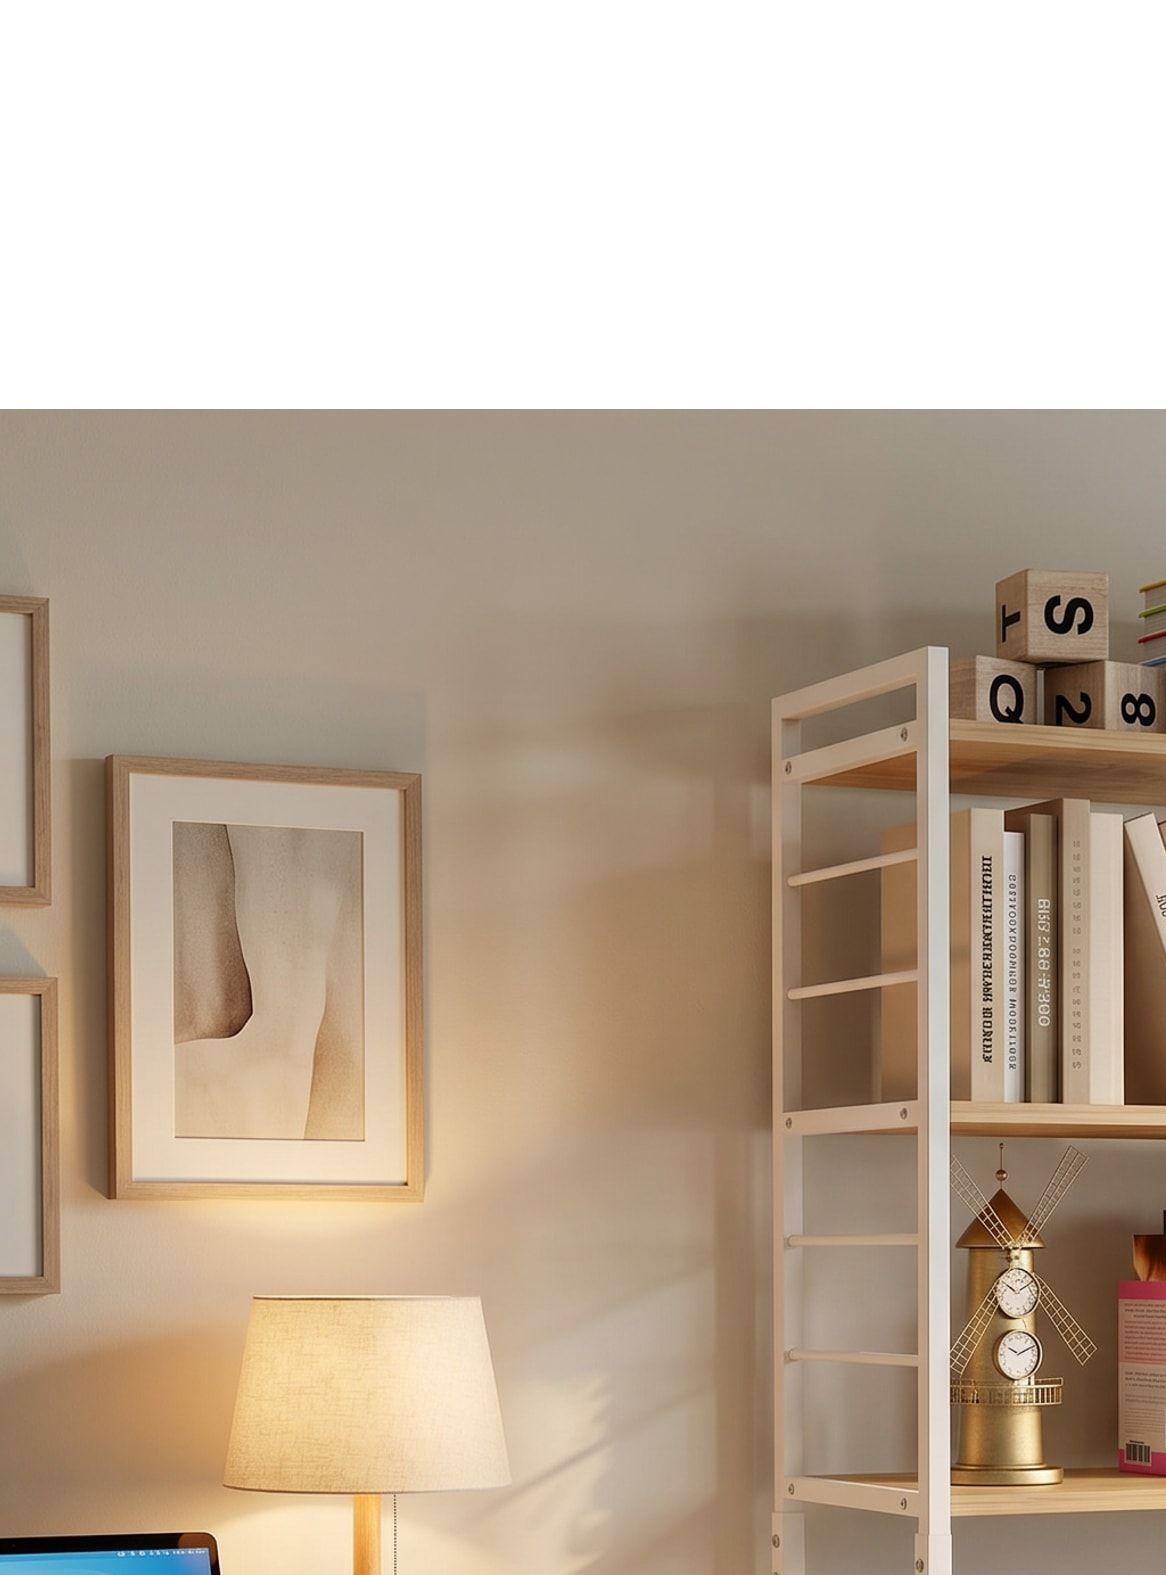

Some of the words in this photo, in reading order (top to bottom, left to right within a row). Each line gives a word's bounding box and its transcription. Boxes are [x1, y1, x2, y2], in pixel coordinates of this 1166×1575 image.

[1001, 604, 1021, 643] T
[1044, 595, 1094, 635] S
[989, 674, 1025, 724] Q
[1055, 691, 1092, 726] 2
[1120, 693, 1156, 726] 8
